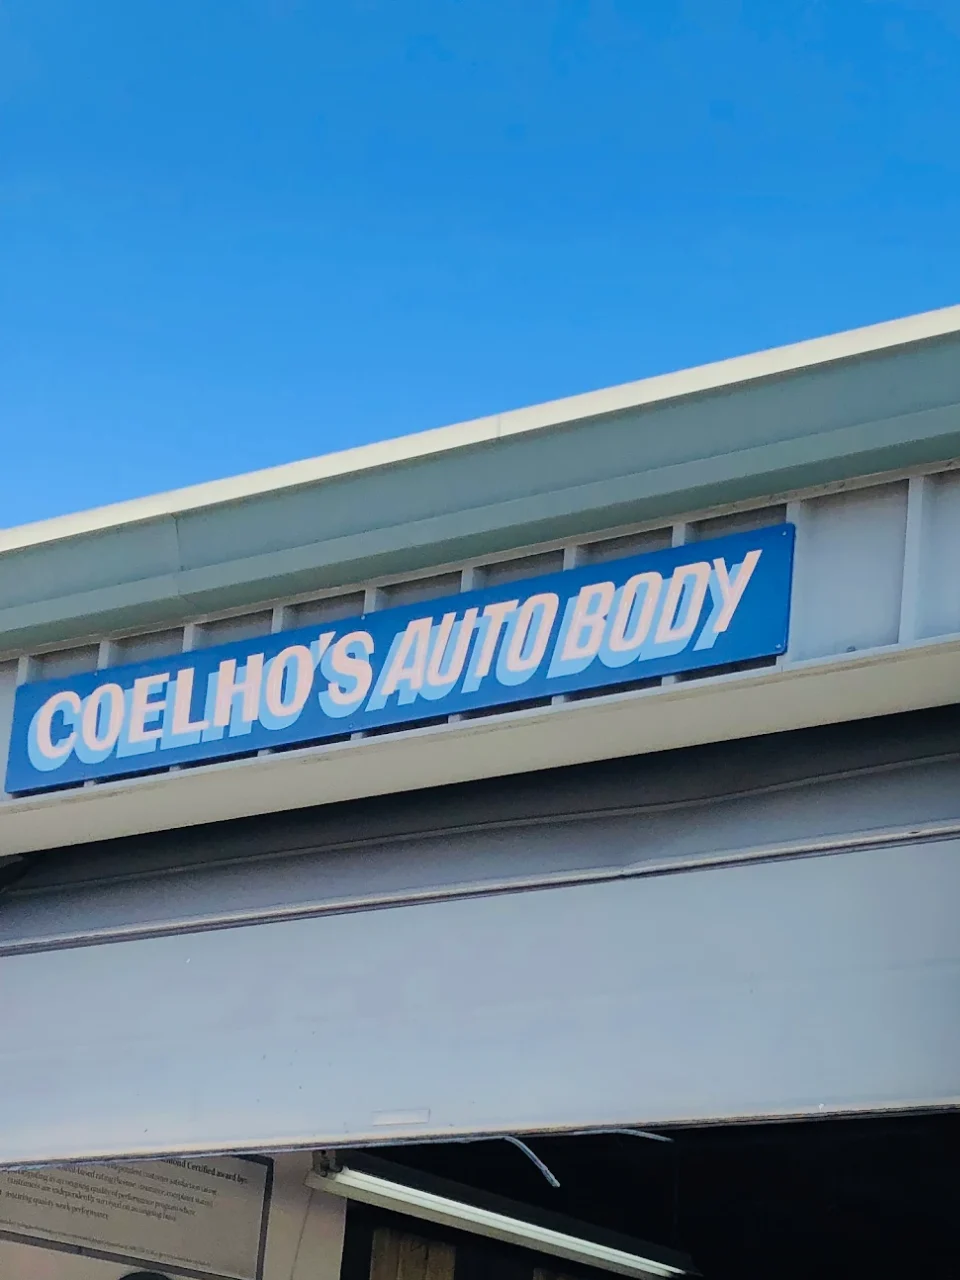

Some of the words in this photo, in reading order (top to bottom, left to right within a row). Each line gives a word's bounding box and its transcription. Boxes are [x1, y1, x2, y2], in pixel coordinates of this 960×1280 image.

[33, 630, 375, 763] COELHO'S
[374, 592, 560, 700] AUTO
[556, 549, 763, 668] BODY
